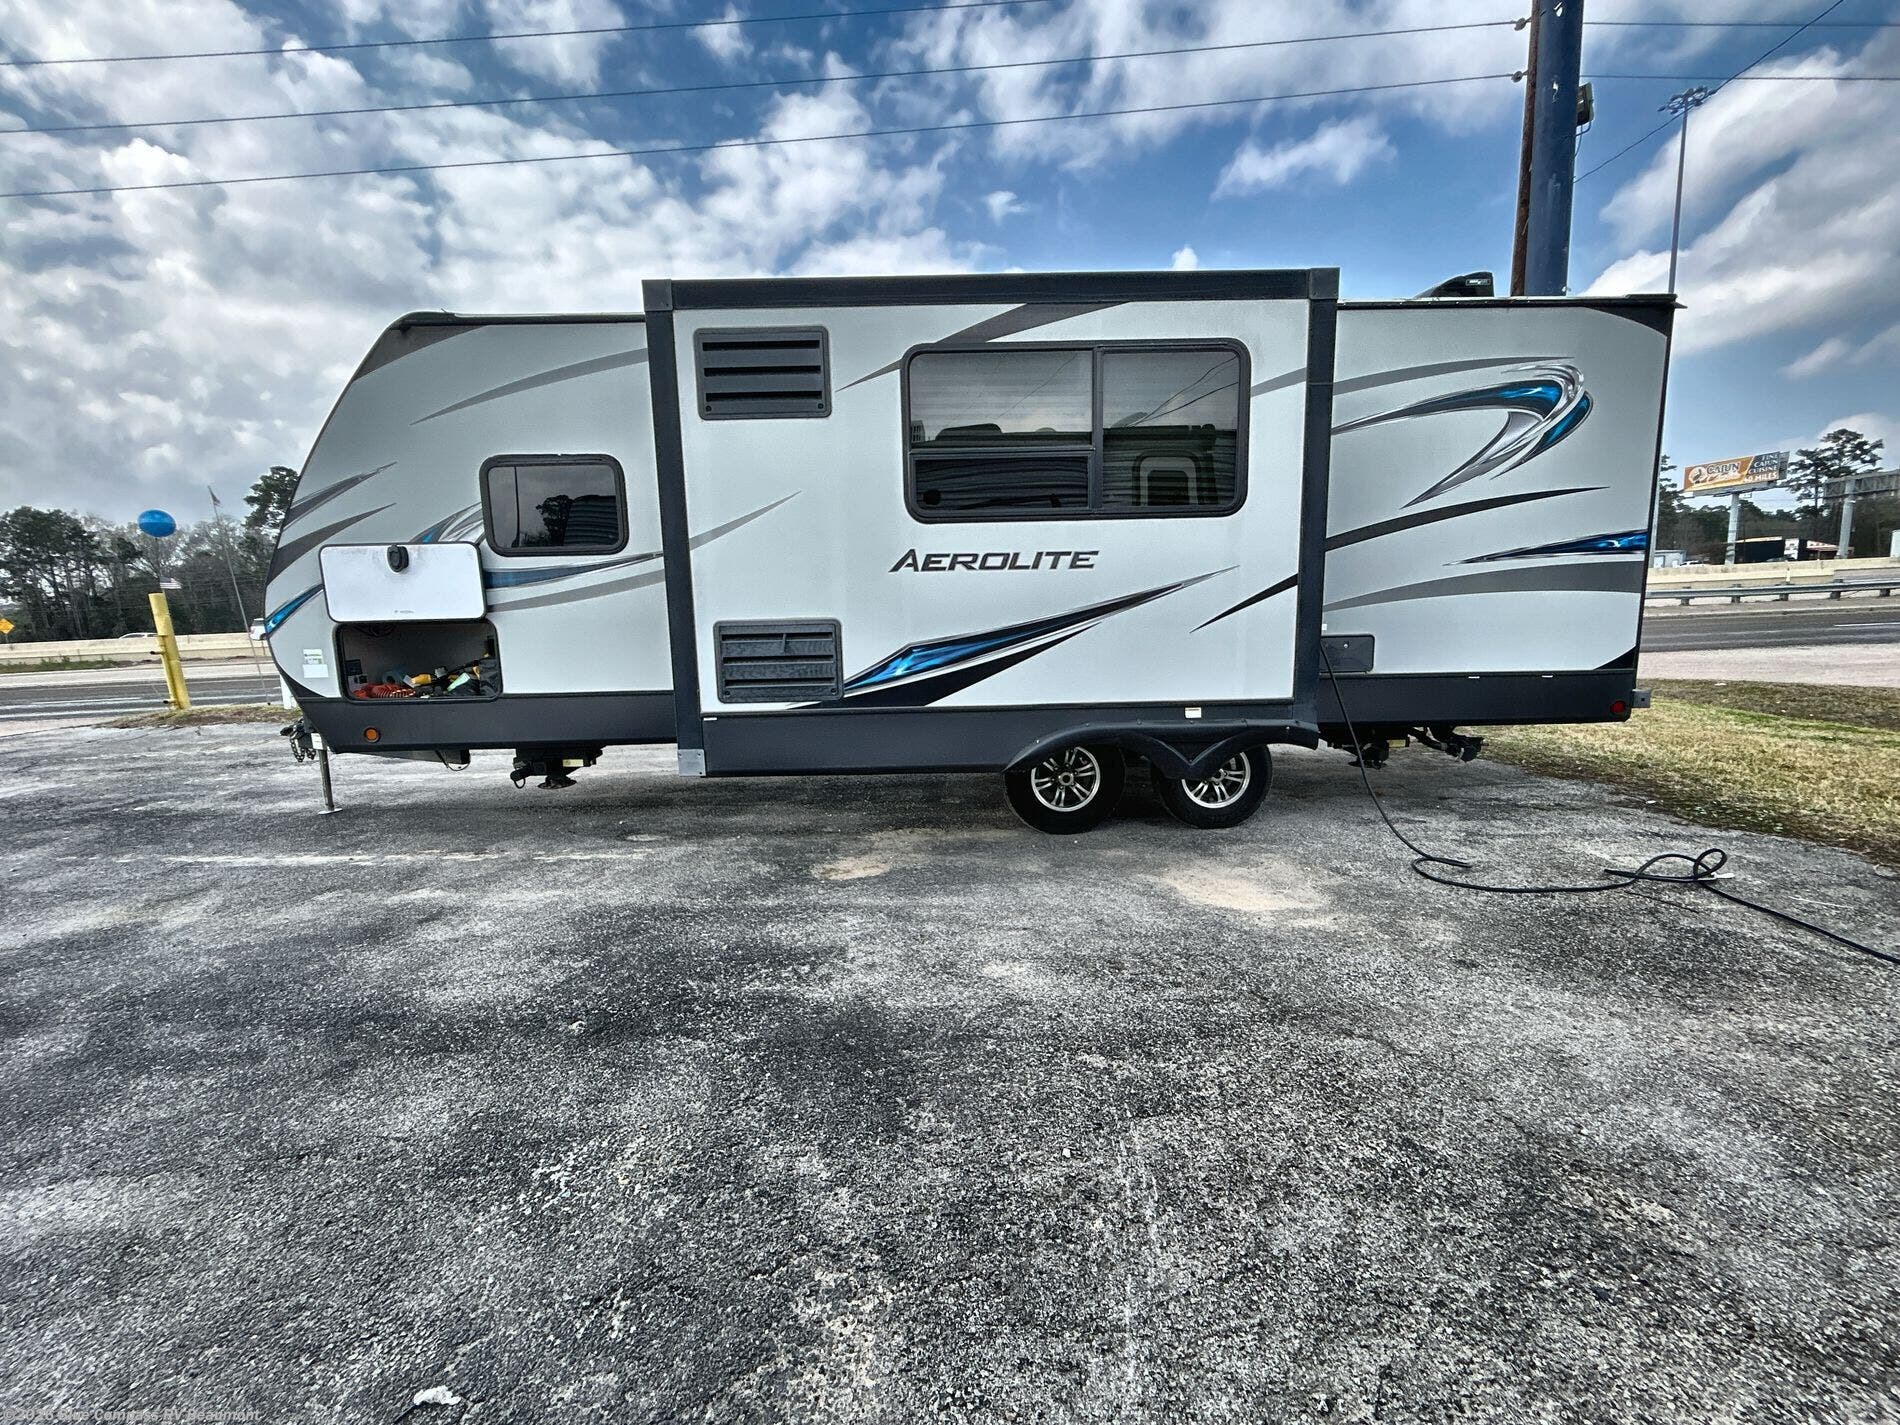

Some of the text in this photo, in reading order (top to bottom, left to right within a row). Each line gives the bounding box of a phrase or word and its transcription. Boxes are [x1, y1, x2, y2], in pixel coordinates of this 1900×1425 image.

[1706, 463, 1740, 474] CAJUN
[1754, 472, 1777, 481] MILES
[888, 548, 1100, 573] AEROLITE
